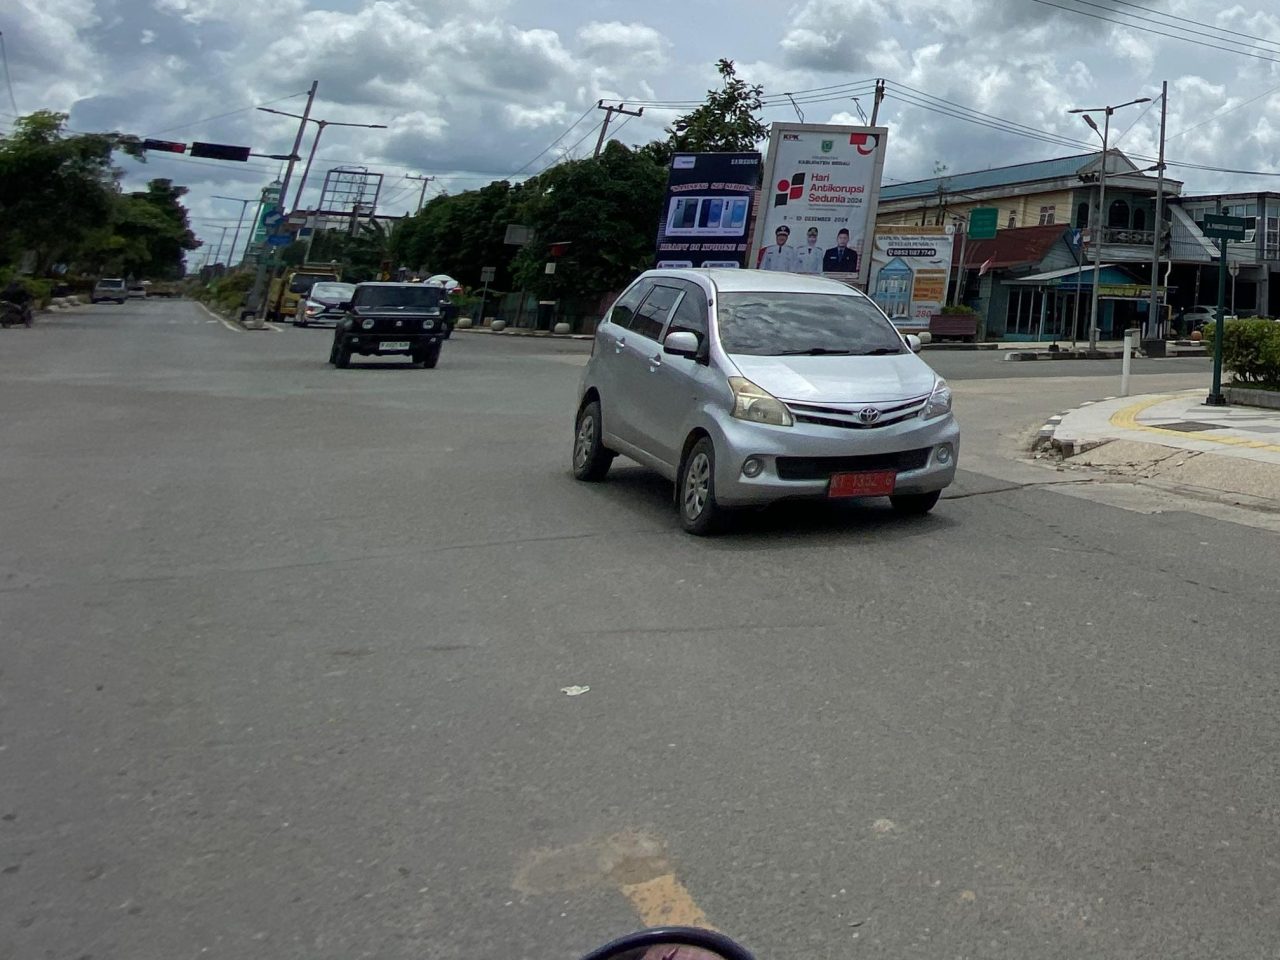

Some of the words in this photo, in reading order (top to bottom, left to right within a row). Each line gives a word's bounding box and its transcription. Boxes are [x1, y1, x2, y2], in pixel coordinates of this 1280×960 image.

[811, 173, 830, 182] Hari
[809, 183, 865, 195] Antikorupsi
[808, 193, 846, 203] Sedunia
